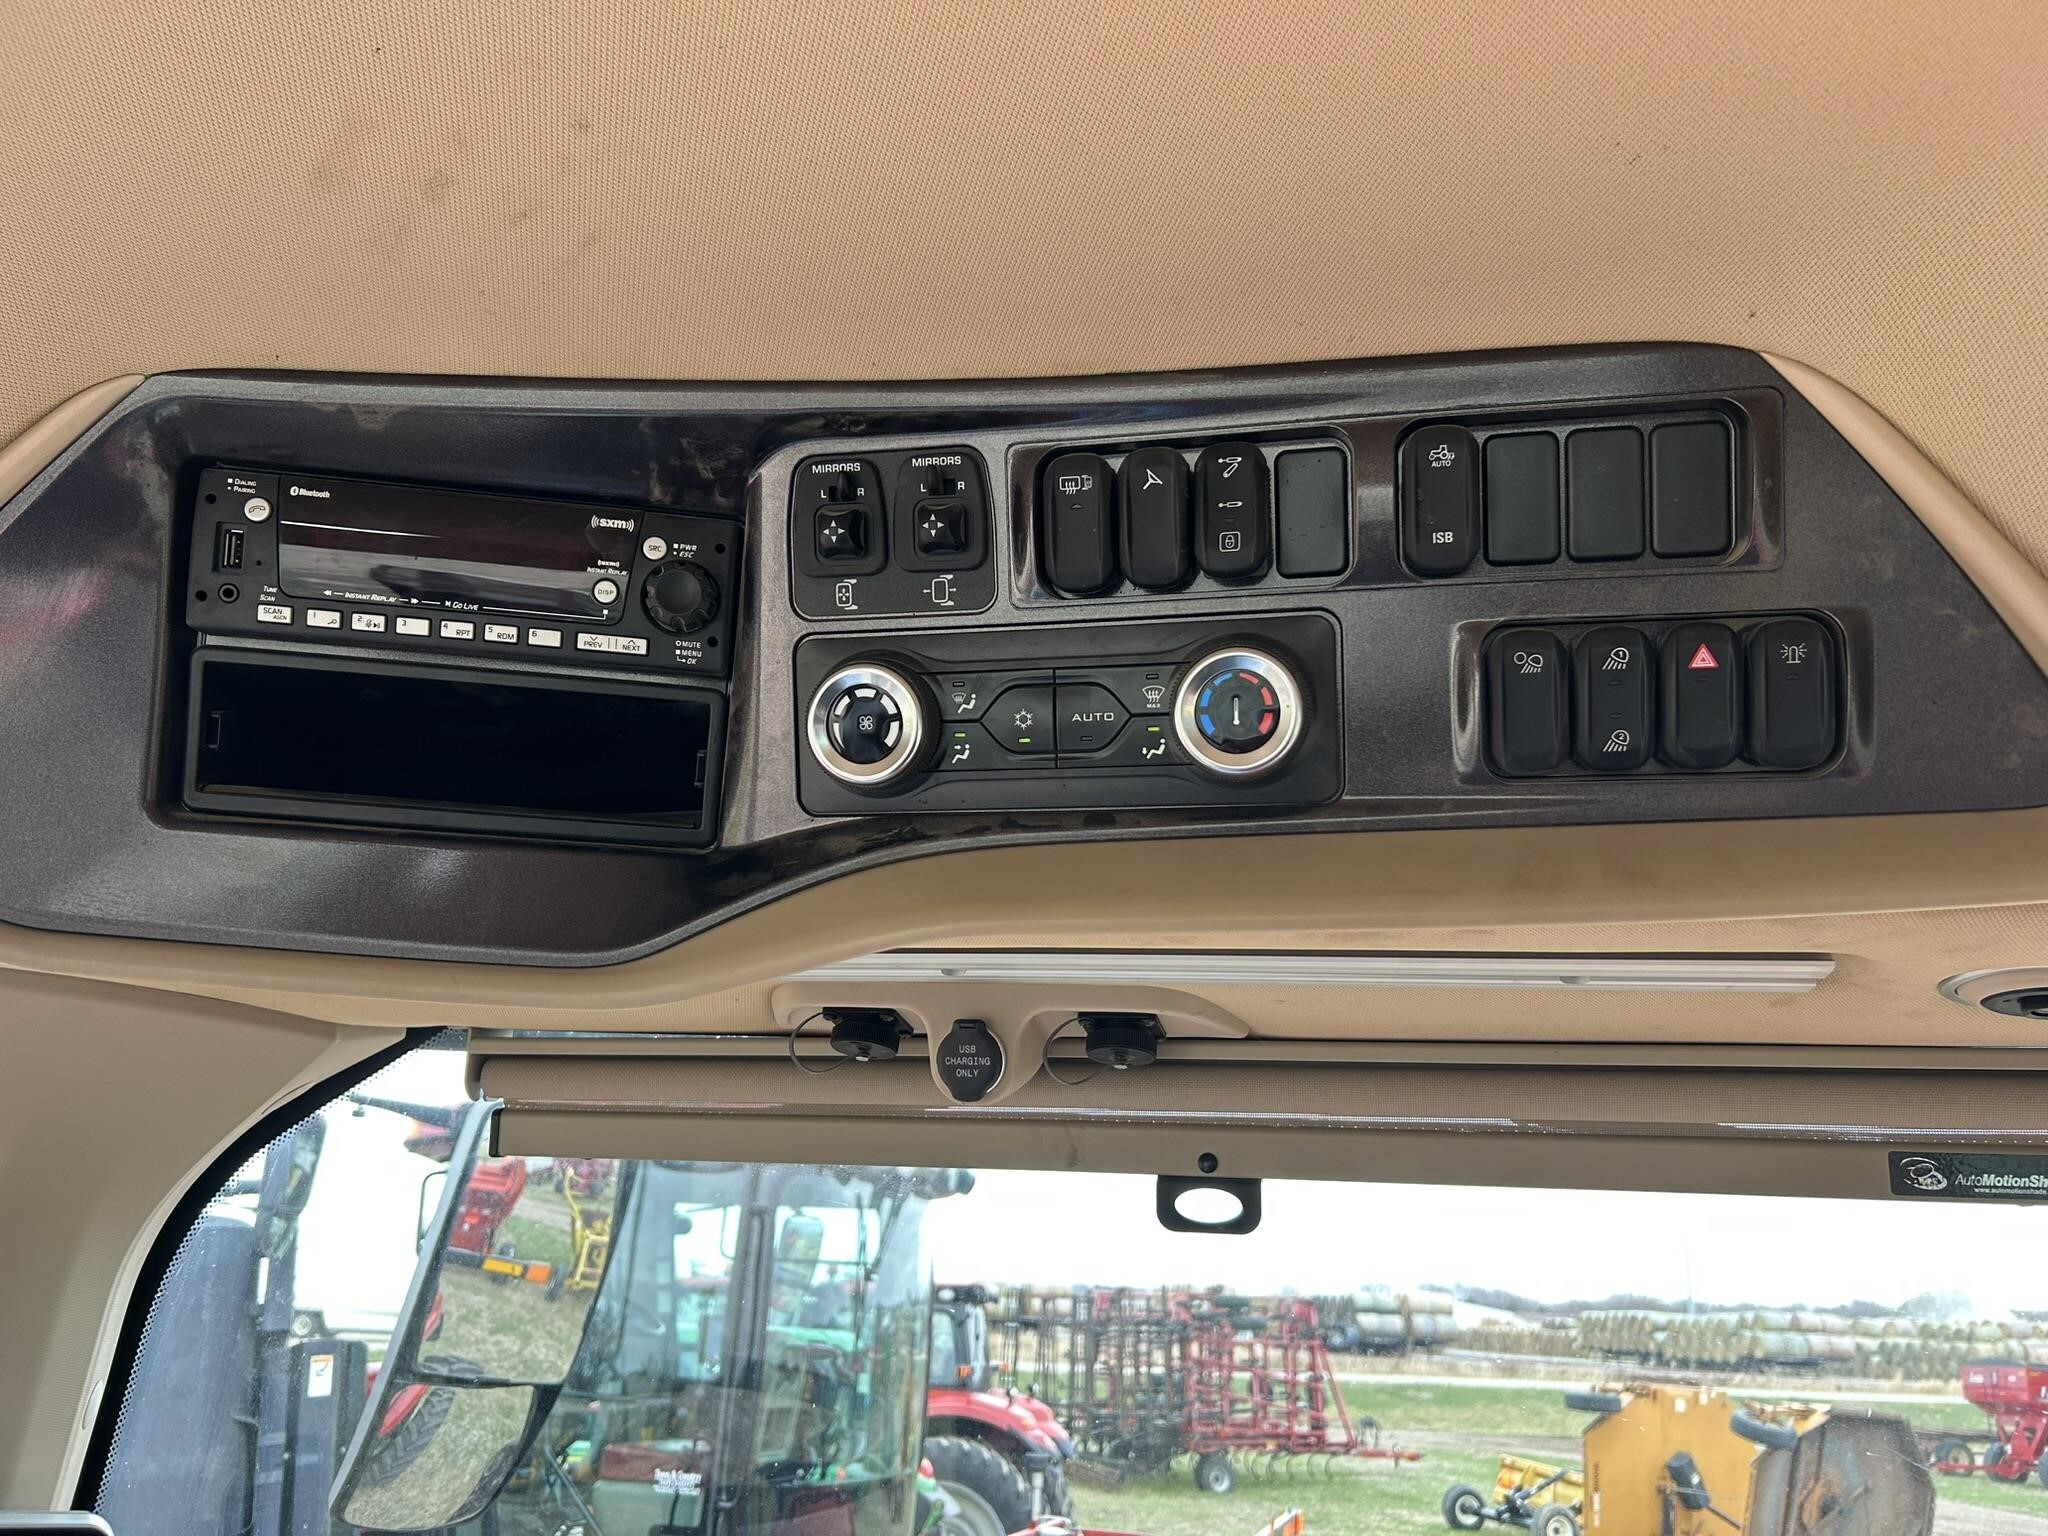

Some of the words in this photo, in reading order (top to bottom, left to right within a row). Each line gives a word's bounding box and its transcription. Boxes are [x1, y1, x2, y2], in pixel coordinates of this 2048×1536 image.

[911, 456, 961, 467] MIRRORS
[812, 462, 860, 474] MIRRORS
[920, 484, 926, 492] L
[957, 481, 965, 490] R
[299, 488, 330, 498] Bluetooth
[821, 490, 827, 498] L
[857, 488, 865, 496] R
[1432, 532, 1453, 543] ISB
[680, 543, 697, 552] PWR
[679, 551, 694, 559] ESC
[263, 607, 283, 615] SCAN
[496, 632, 515, 640] RDM
[583, 640, 603, 648] PREV
[622, 644, 641, 652] NEXT
[682, 641, 702, 649] MUTE
[681, 649, 702, 658] MENU
[1072, 712, 1114, 722] AUTO
[959, 1045, 976, 1053] USB
[944, 1057, 990, 1065] CHARGING
[955, 1069, 979, 1077] ONLY
